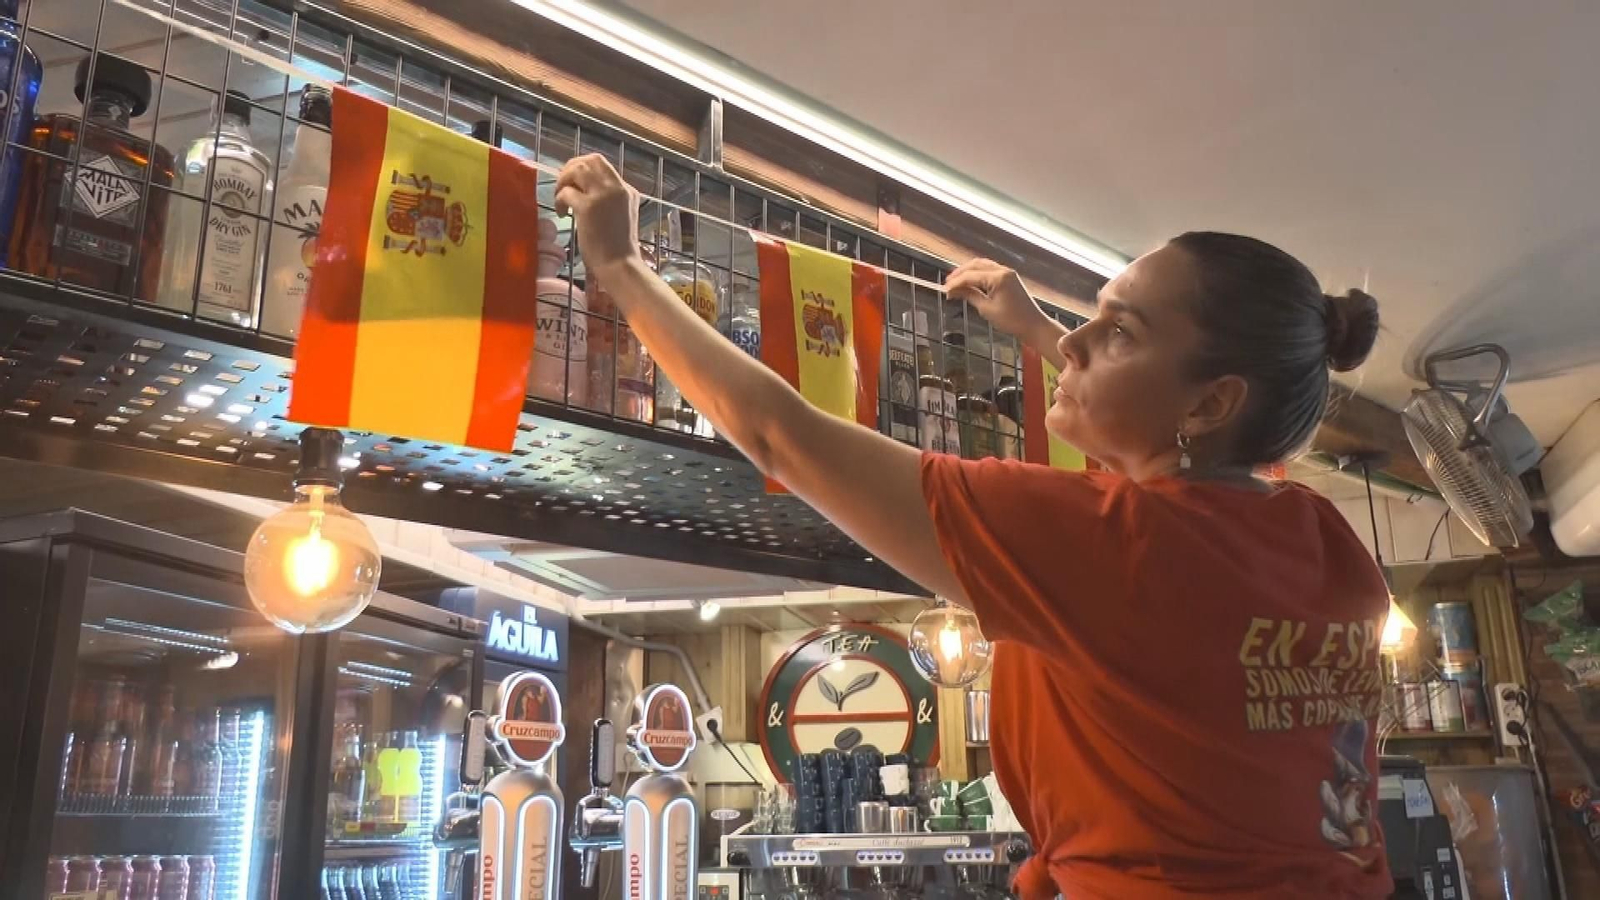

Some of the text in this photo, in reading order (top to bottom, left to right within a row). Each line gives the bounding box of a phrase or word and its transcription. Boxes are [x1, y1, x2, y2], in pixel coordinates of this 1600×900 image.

[213, 177, 255, 200] BOMBAY
[488, 610, 559, 662] ÁGUILA
[822, 634, 880, 654] TEA
[1239, 617, 1307, 668] EN
[768, 701, 785, 728] &
[917, 697, 933, 725] &
[1246, 697, 1294, 731] MÁS
[502, 724, 561, 741] Cruzcampo
[643, 732, 694, 748] Cruzcampo
